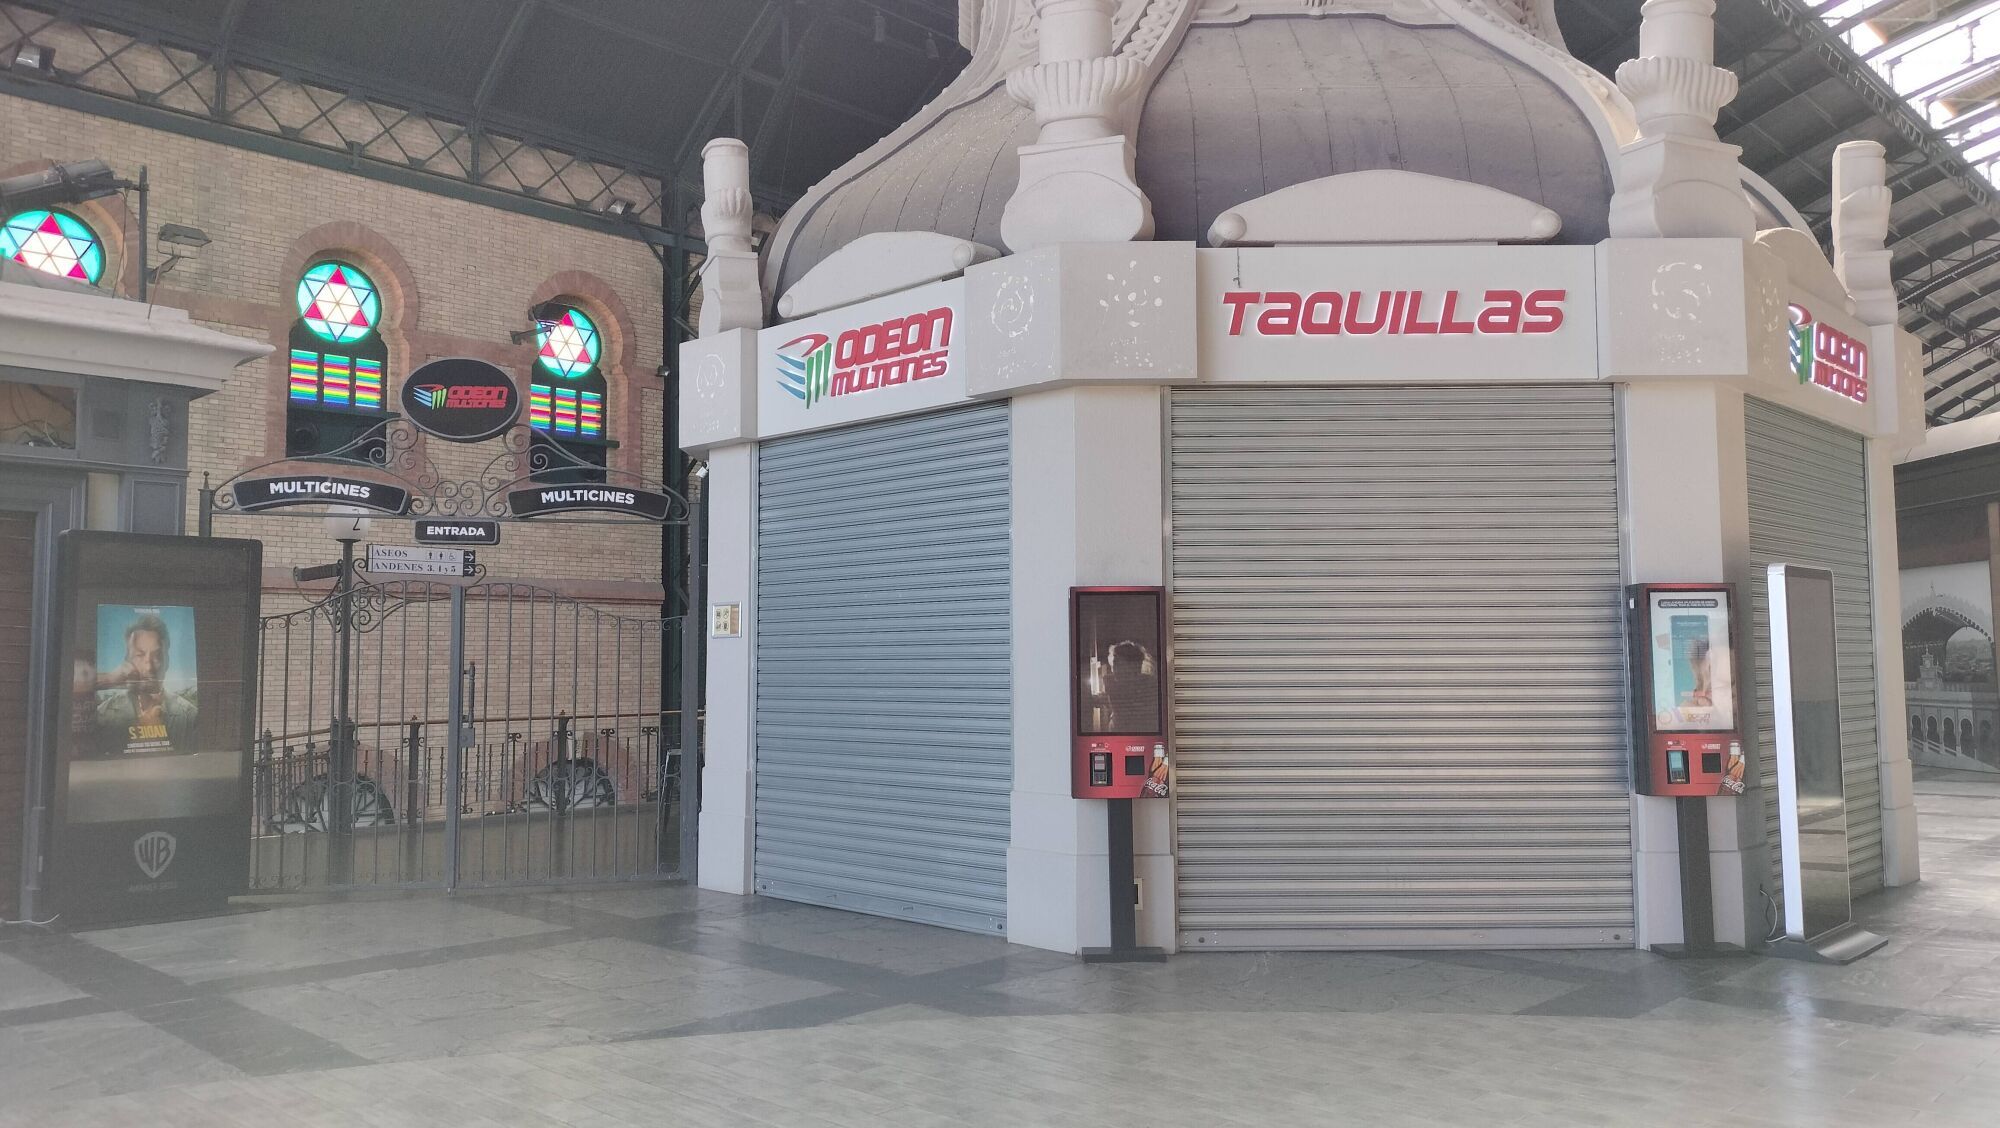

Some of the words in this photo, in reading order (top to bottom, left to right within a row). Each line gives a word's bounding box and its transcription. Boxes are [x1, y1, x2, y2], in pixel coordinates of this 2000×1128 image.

[835, 306, 954, 370] ODEON
[1815, 321, 1868, 381] ODEON
[830, 350, 949, 397] MULTICINES
[448, 385, 509, 400] ODEON
[269, 481, 371, 499] MULTICINES
[540, 488, 636, 505] MULTICINES
[426, 525, 486, 537] ENTRADA
[373, 548, 408, 558] ASEOS
[373, 562, 423, 571] ANDENES
[450, 565, 456, 573] 5
